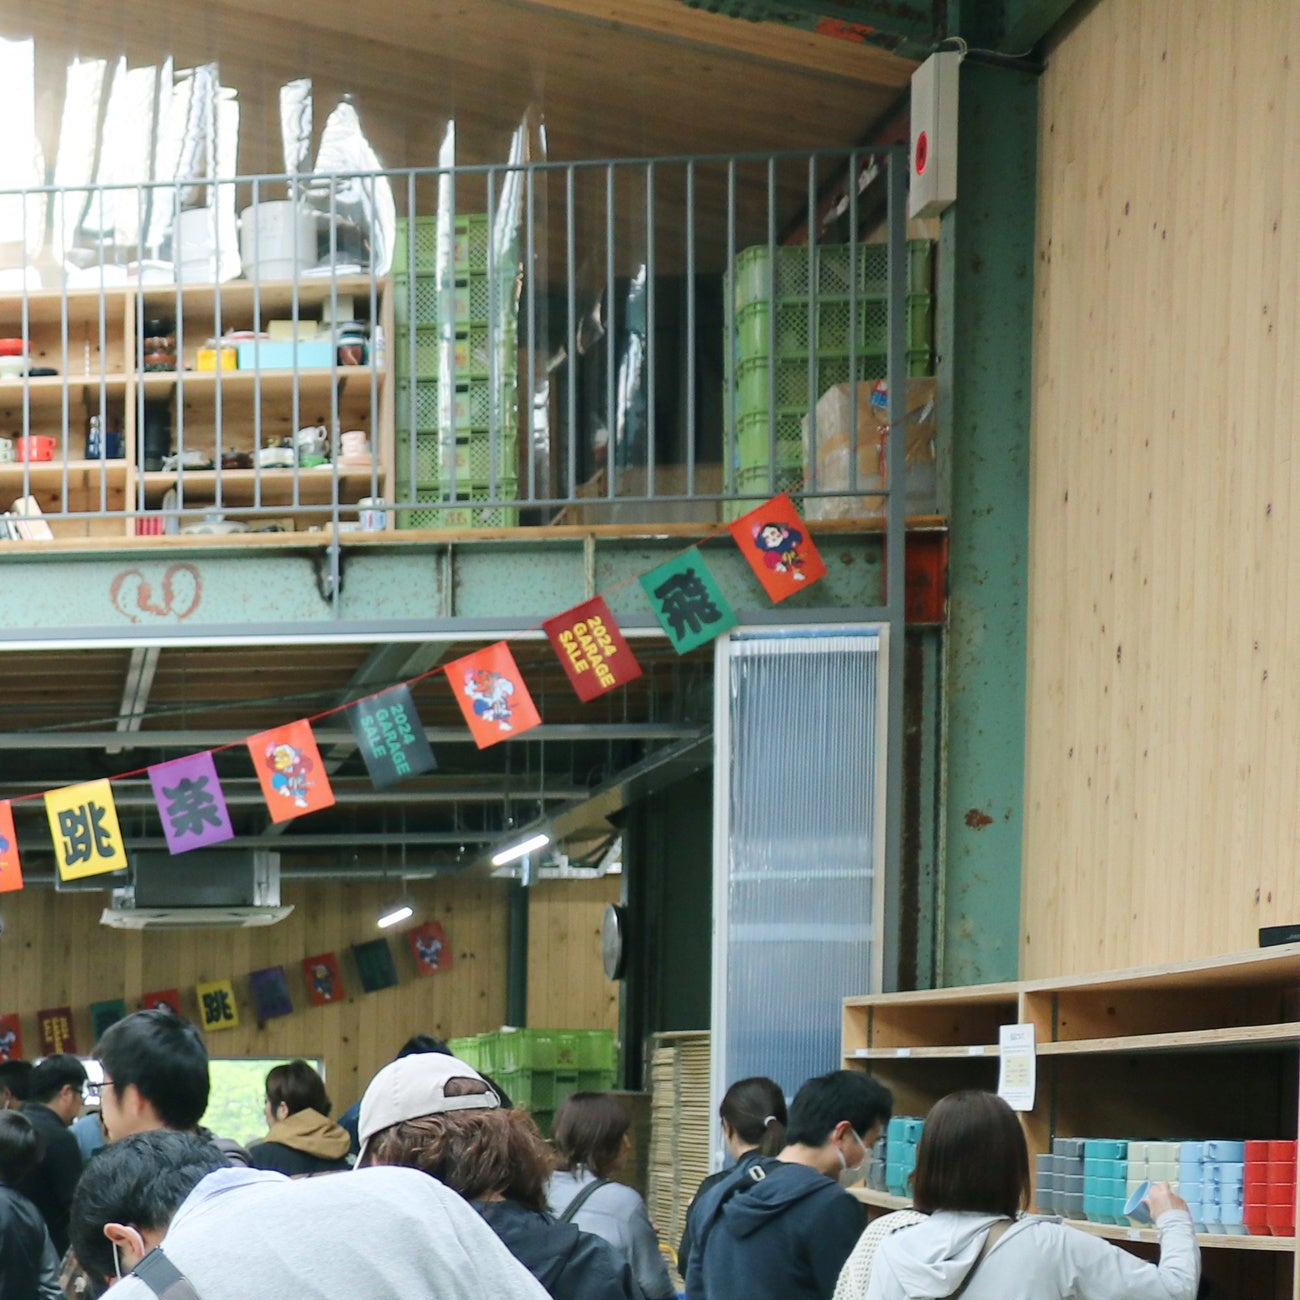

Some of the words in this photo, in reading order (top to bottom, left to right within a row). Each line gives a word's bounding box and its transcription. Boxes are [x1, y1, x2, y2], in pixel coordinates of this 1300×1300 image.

[654, 567, 722, 642] 飛
[559, 630, 590, 674] SALE
[573, 622, 616, 688] GARAGE
[587, 615, 617, 657] 2024
[361, 715, 387, 759] SALE
[375, 708, 411, 776] GARAGE
[390, 703, 416, 745] 2024
[161, 775, 223, 837] 楽
[58, 801, 116, 866] 跳
[202, 988, 233, 1024] 跳
